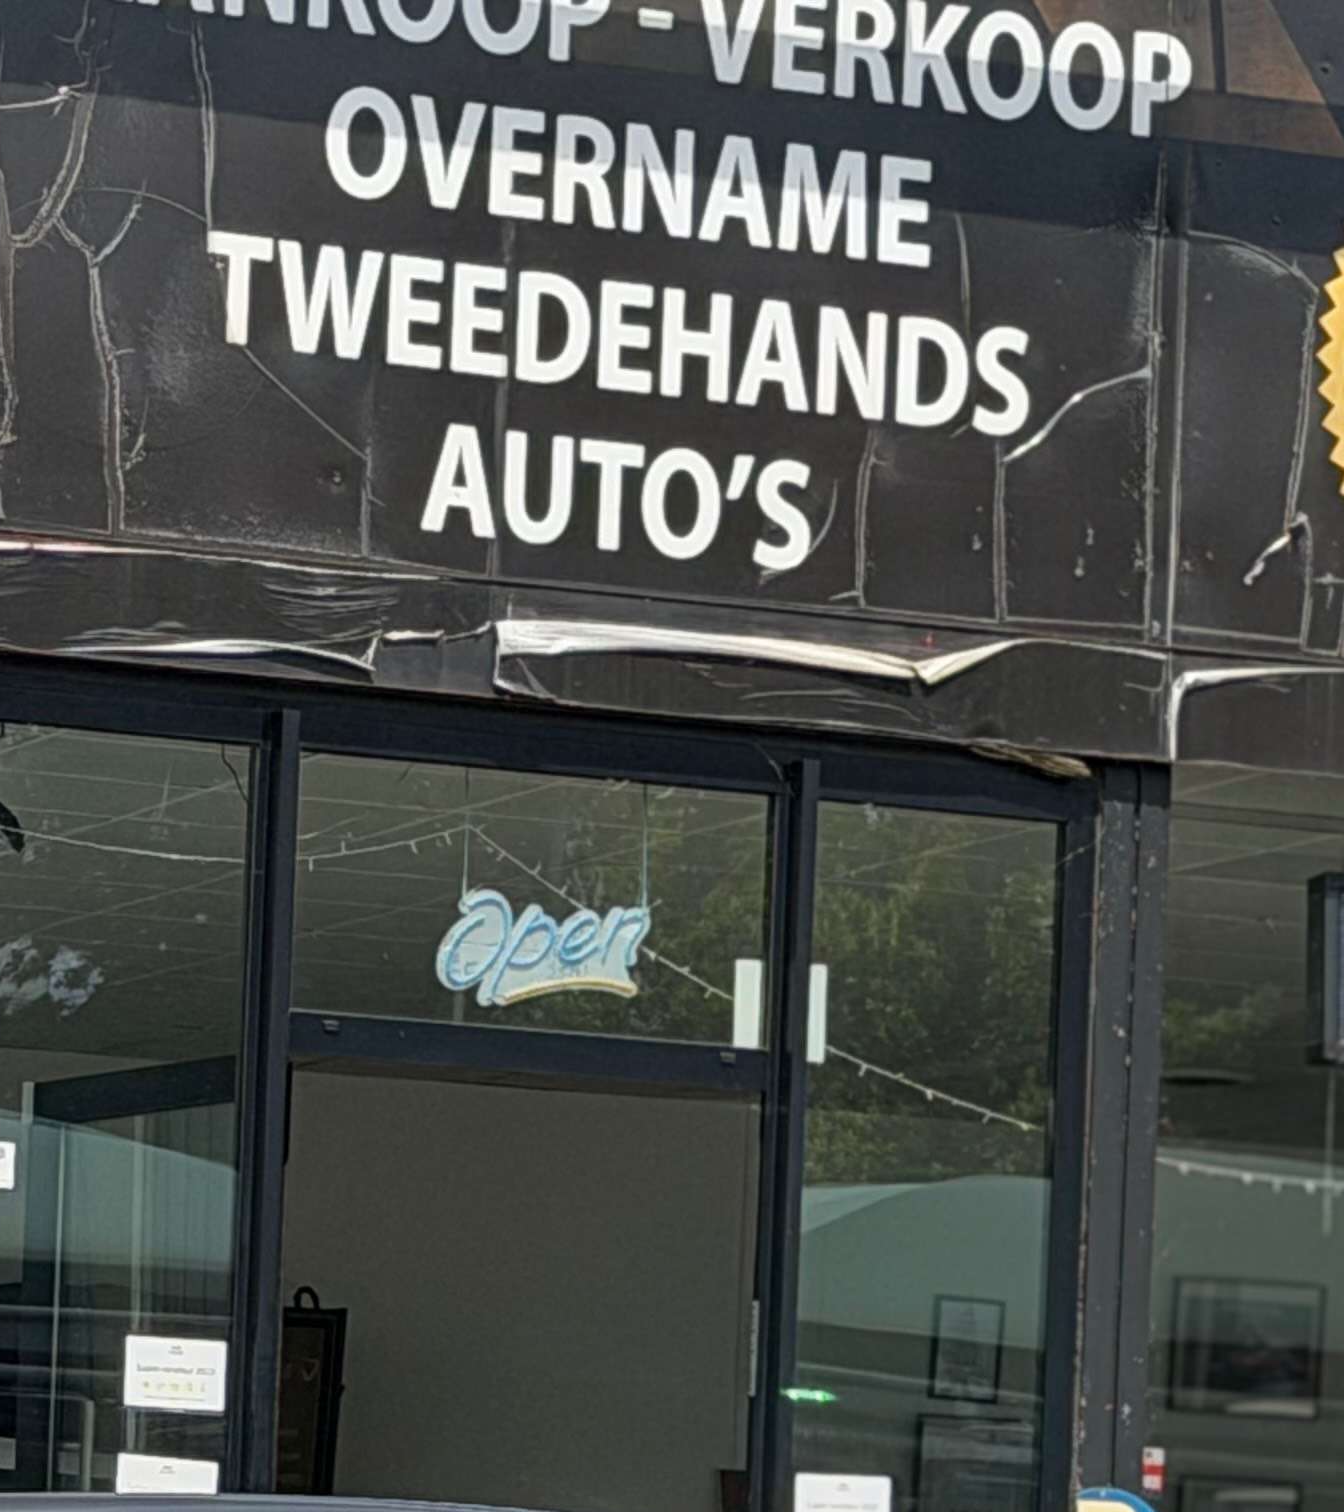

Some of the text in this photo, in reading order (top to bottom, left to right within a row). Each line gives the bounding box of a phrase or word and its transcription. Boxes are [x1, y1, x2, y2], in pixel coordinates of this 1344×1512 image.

[700, 0, 1193, 137] VERKOOP
[324, 86, 933, 268] OVERNAME
[206, 229, 1031, 438] TWEEDEHANDS
[438, 890, 650, 1006] Open
